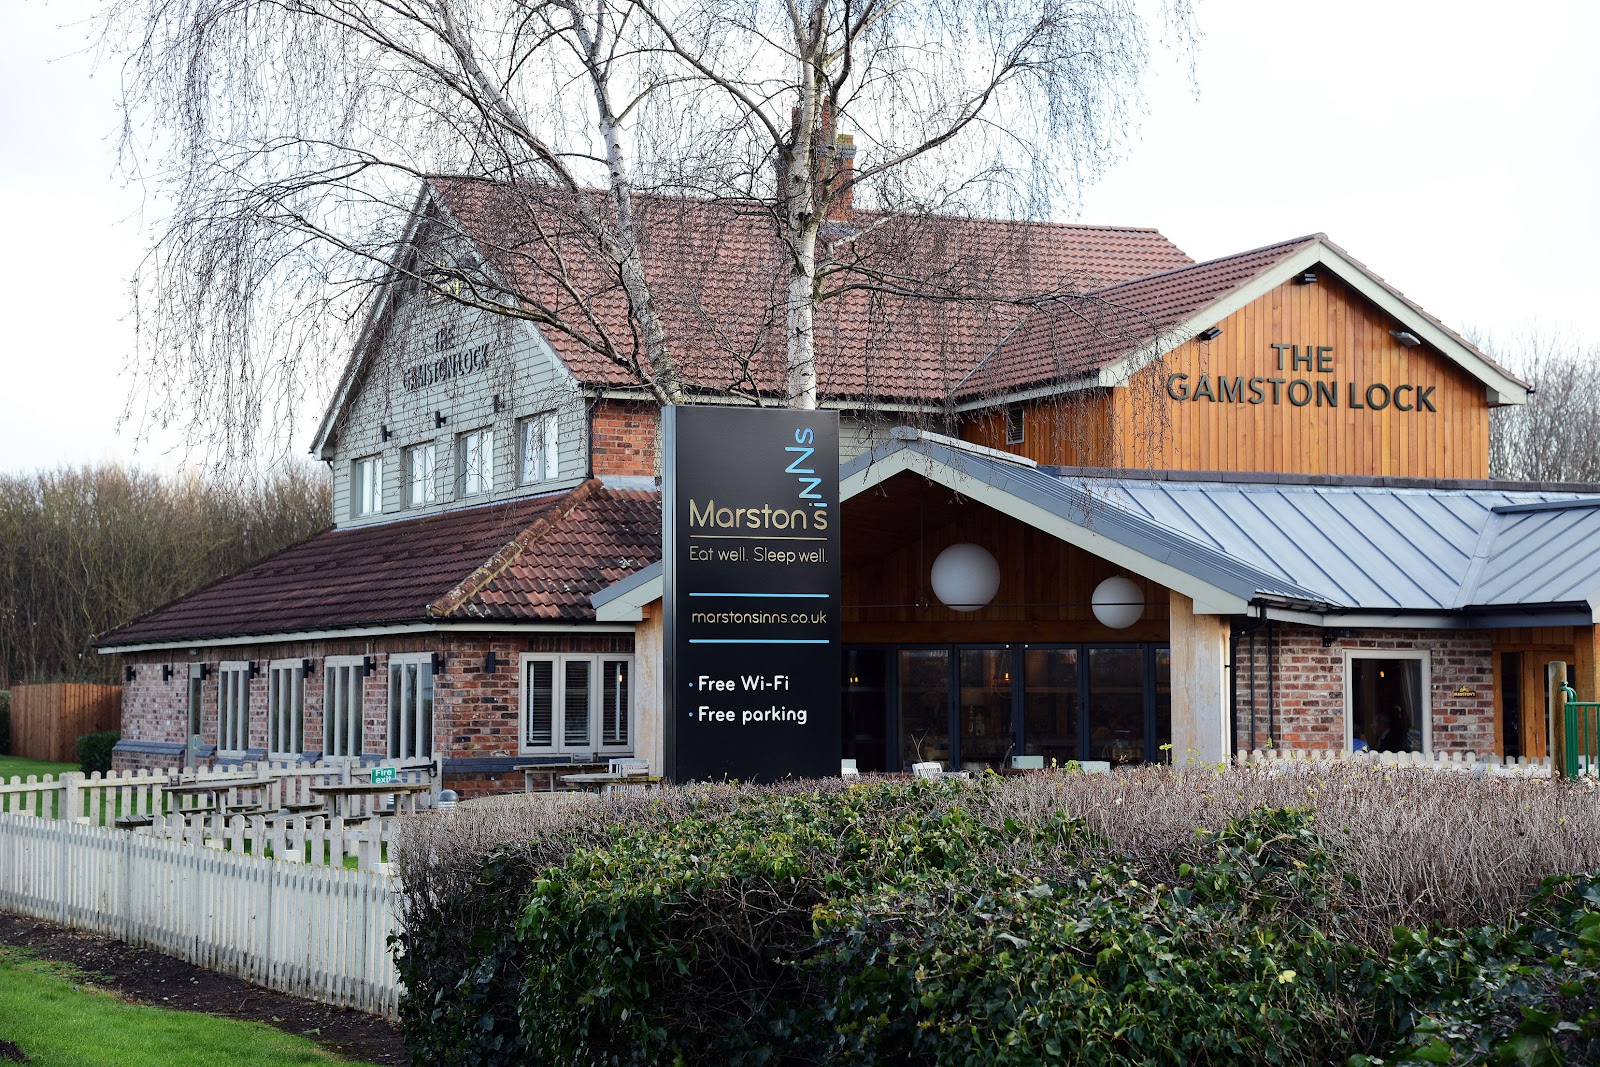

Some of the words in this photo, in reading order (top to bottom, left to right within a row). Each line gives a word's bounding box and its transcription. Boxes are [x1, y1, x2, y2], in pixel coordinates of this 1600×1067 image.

[1270, 343, 1334, 373] THE
[1167, 372, 1339, 407] GAMSTON
[1349, 382, 1437, 412] LOCK
[689, 545, 714, 561] Eat
[718, 546, 749, 562] well.
[754, 546, 796, 565] Sleep
[798, 548, 828, 563] well.
[691, 610, 827, 624] marstonsinns.co.uk
[698, 675, 736, 691] Free
[741, 675, 789, 691] Wi-Fi
[698, 705, 736, 722] Free
[742, 705, 807, 725] parking
[375, 776, 392, 784] exit
